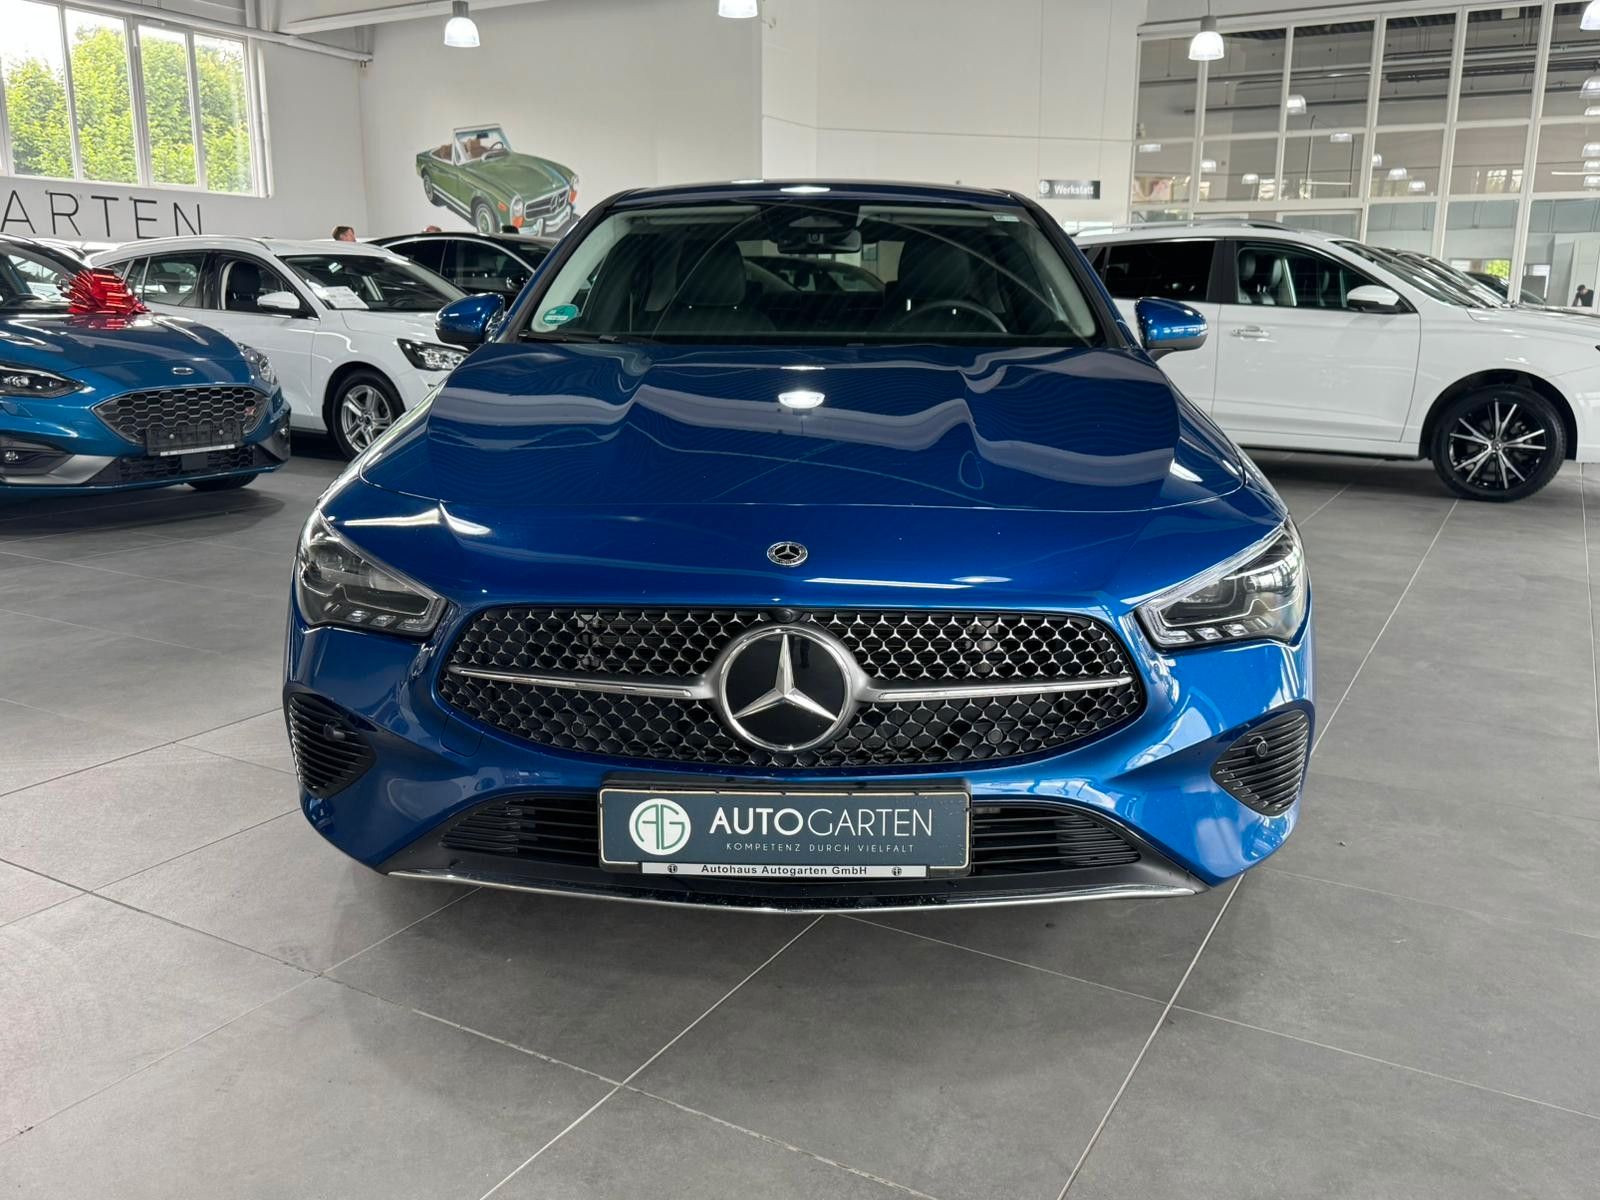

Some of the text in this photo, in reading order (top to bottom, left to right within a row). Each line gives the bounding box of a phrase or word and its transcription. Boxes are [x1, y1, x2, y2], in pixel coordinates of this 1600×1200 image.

[1054, 184, 1094, 195] Werkstatt
[0, 189, 202, 240] ARTEN
[709, 806, 933, 837] AUTOGARTEN
[726, 842, 914, 853] KOMPETENZ DURCH VIELFALT
[701, 864, 868, 877] Autohaus Autogarten GmbH
